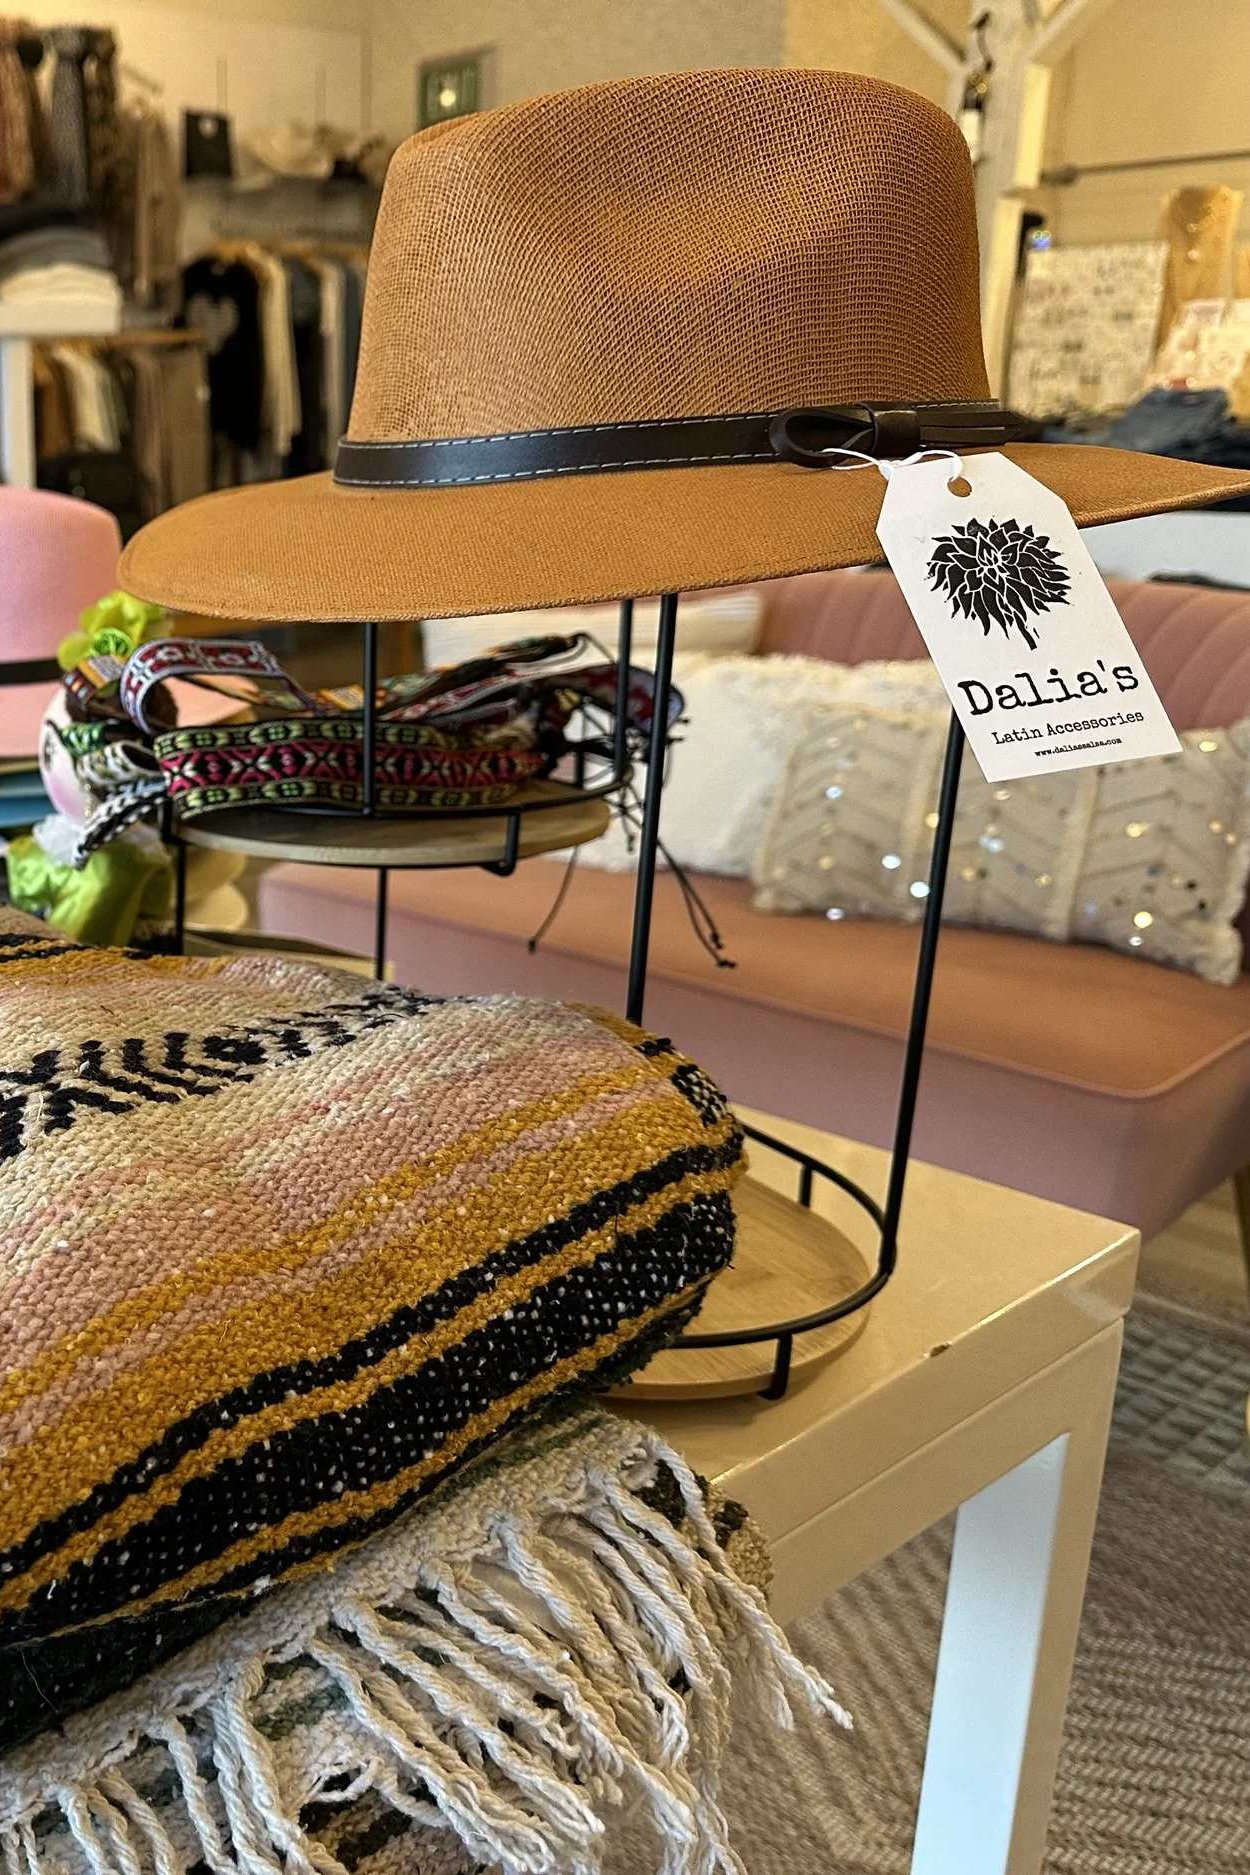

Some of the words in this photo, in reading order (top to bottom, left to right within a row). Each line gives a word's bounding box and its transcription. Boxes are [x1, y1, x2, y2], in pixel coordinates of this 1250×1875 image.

[957, 659, 1139, 717] Dalia's
[991, 727, 1043, 745] Latin
[1047, 711, 1145, 736] Accessories
